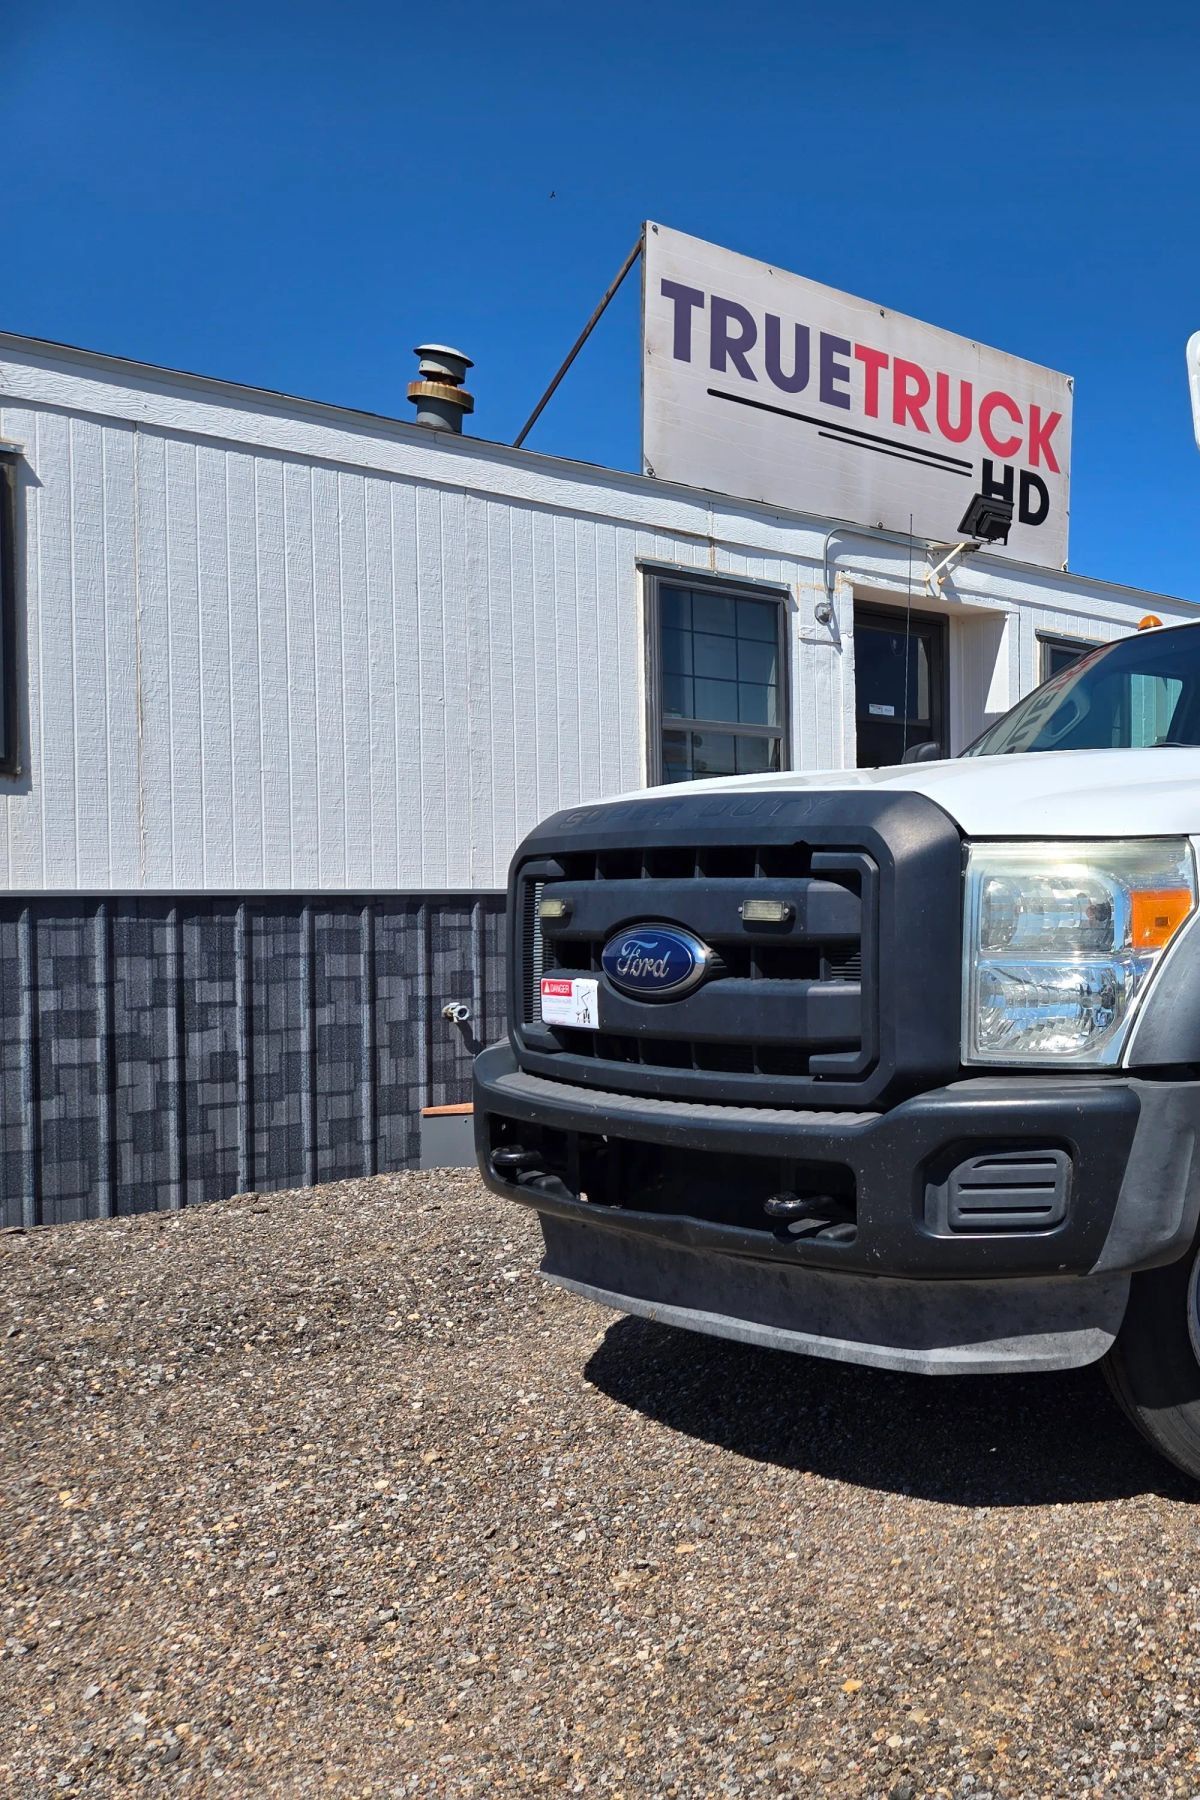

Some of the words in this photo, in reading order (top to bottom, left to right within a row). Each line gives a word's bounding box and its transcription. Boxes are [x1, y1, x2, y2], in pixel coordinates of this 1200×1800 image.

[982, 458, 1050, 526] HD
[616, 940, 671, 978] Ford
[550, 983, 570, 994] DANGER
